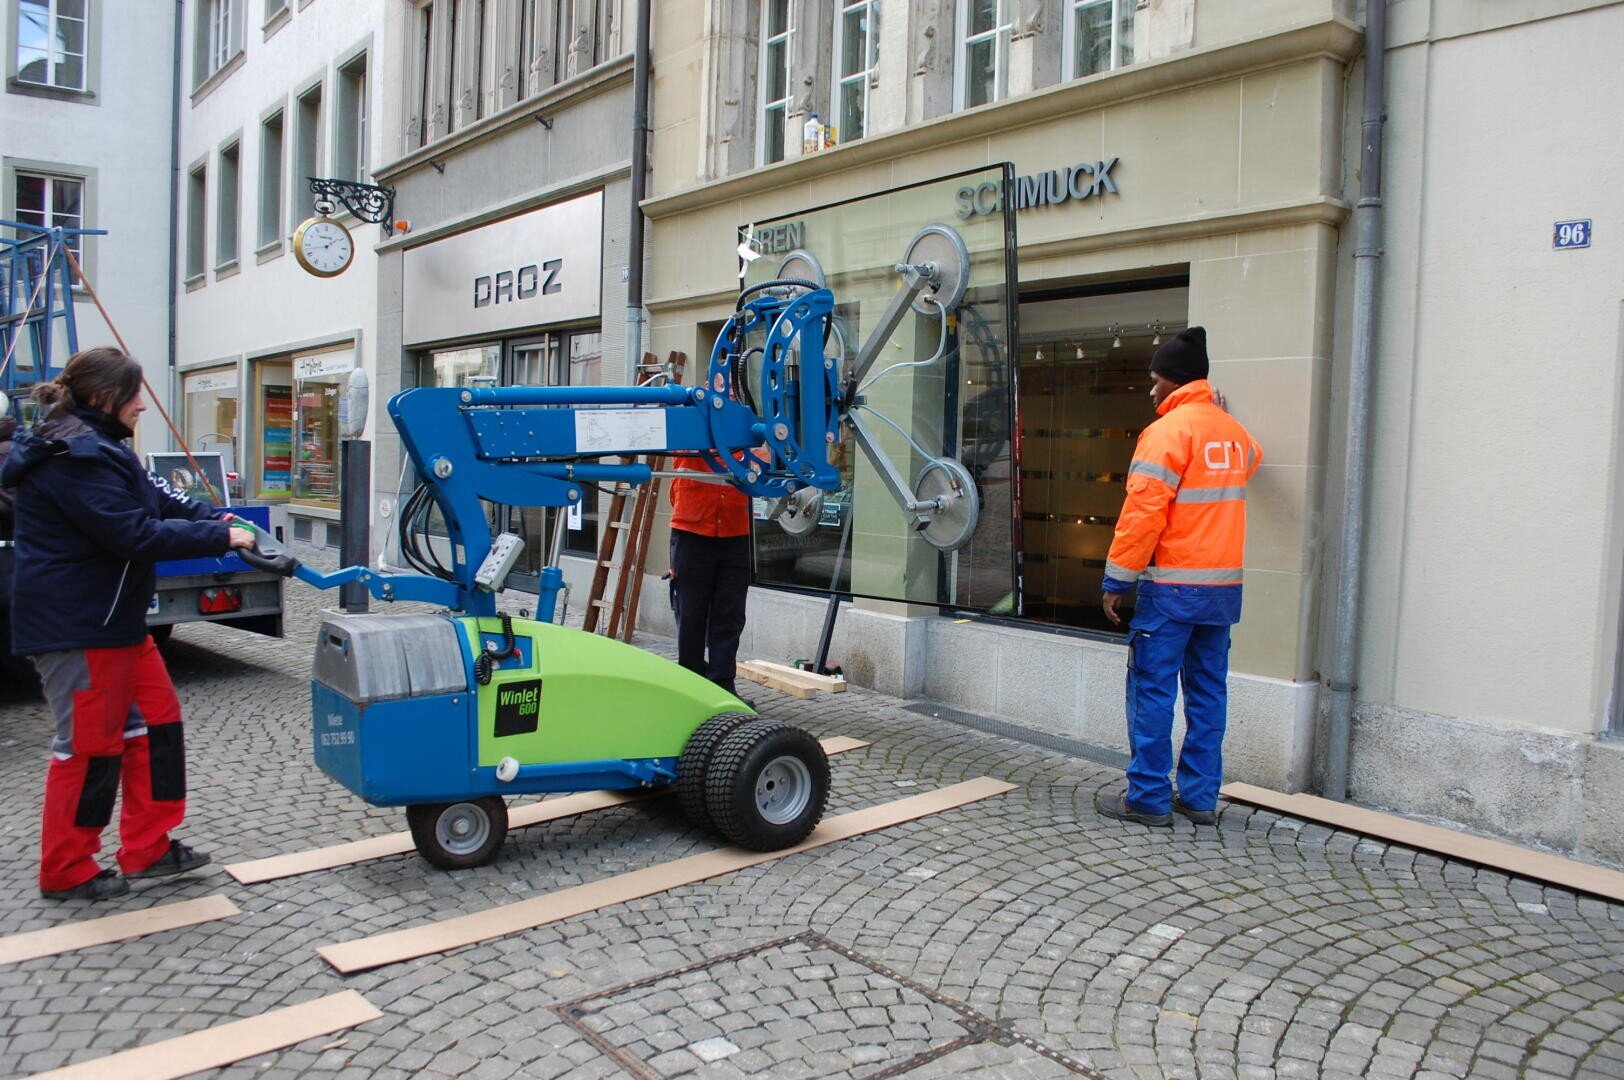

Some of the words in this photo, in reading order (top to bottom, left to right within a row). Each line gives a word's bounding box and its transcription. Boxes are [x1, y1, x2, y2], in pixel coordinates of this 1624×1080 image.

[1559, 223, 1584, 246] 96
[474, 258, 562, 309] DROZ
[500, 687, 538, 706] Winlet
[519, 702, 537, 715] 600
